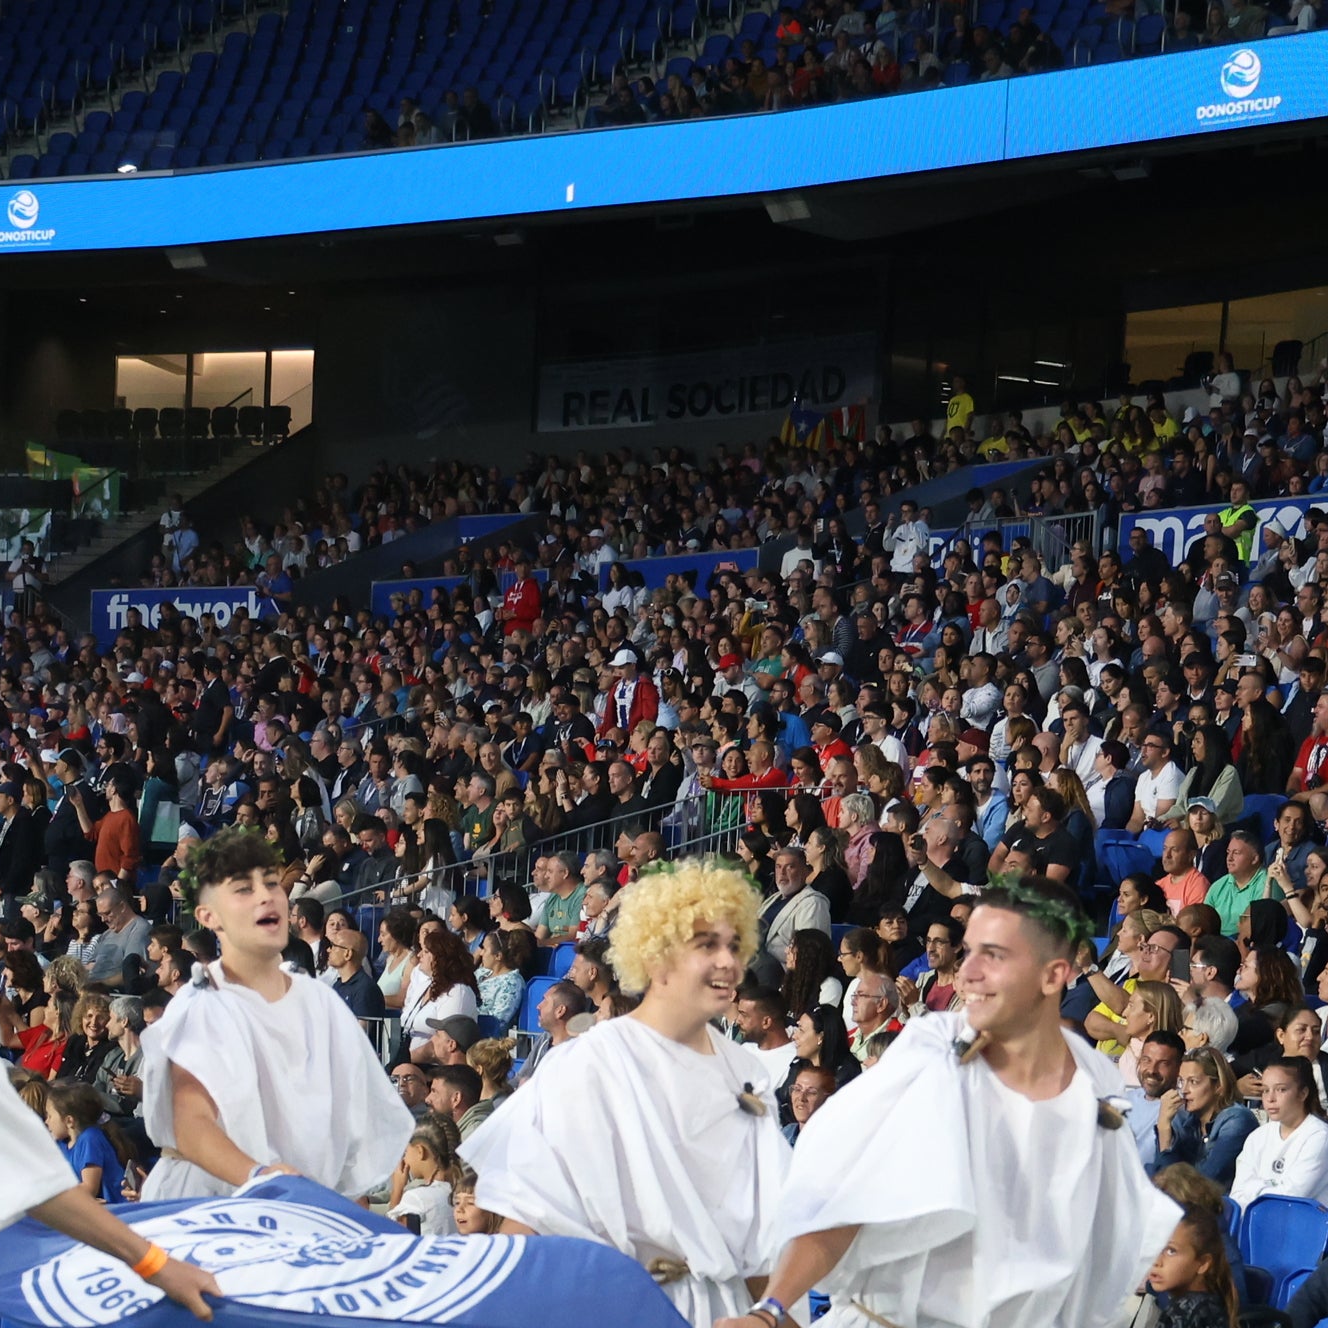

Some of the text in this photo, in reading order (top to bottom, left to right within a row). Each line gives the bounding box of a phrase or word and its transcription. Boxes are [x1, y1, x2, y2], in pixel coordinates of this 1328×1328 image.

[1197, 96, 1281, 120] DONOSTICUP
[563, 366, 847, 428] REAL SOCIEDAD
